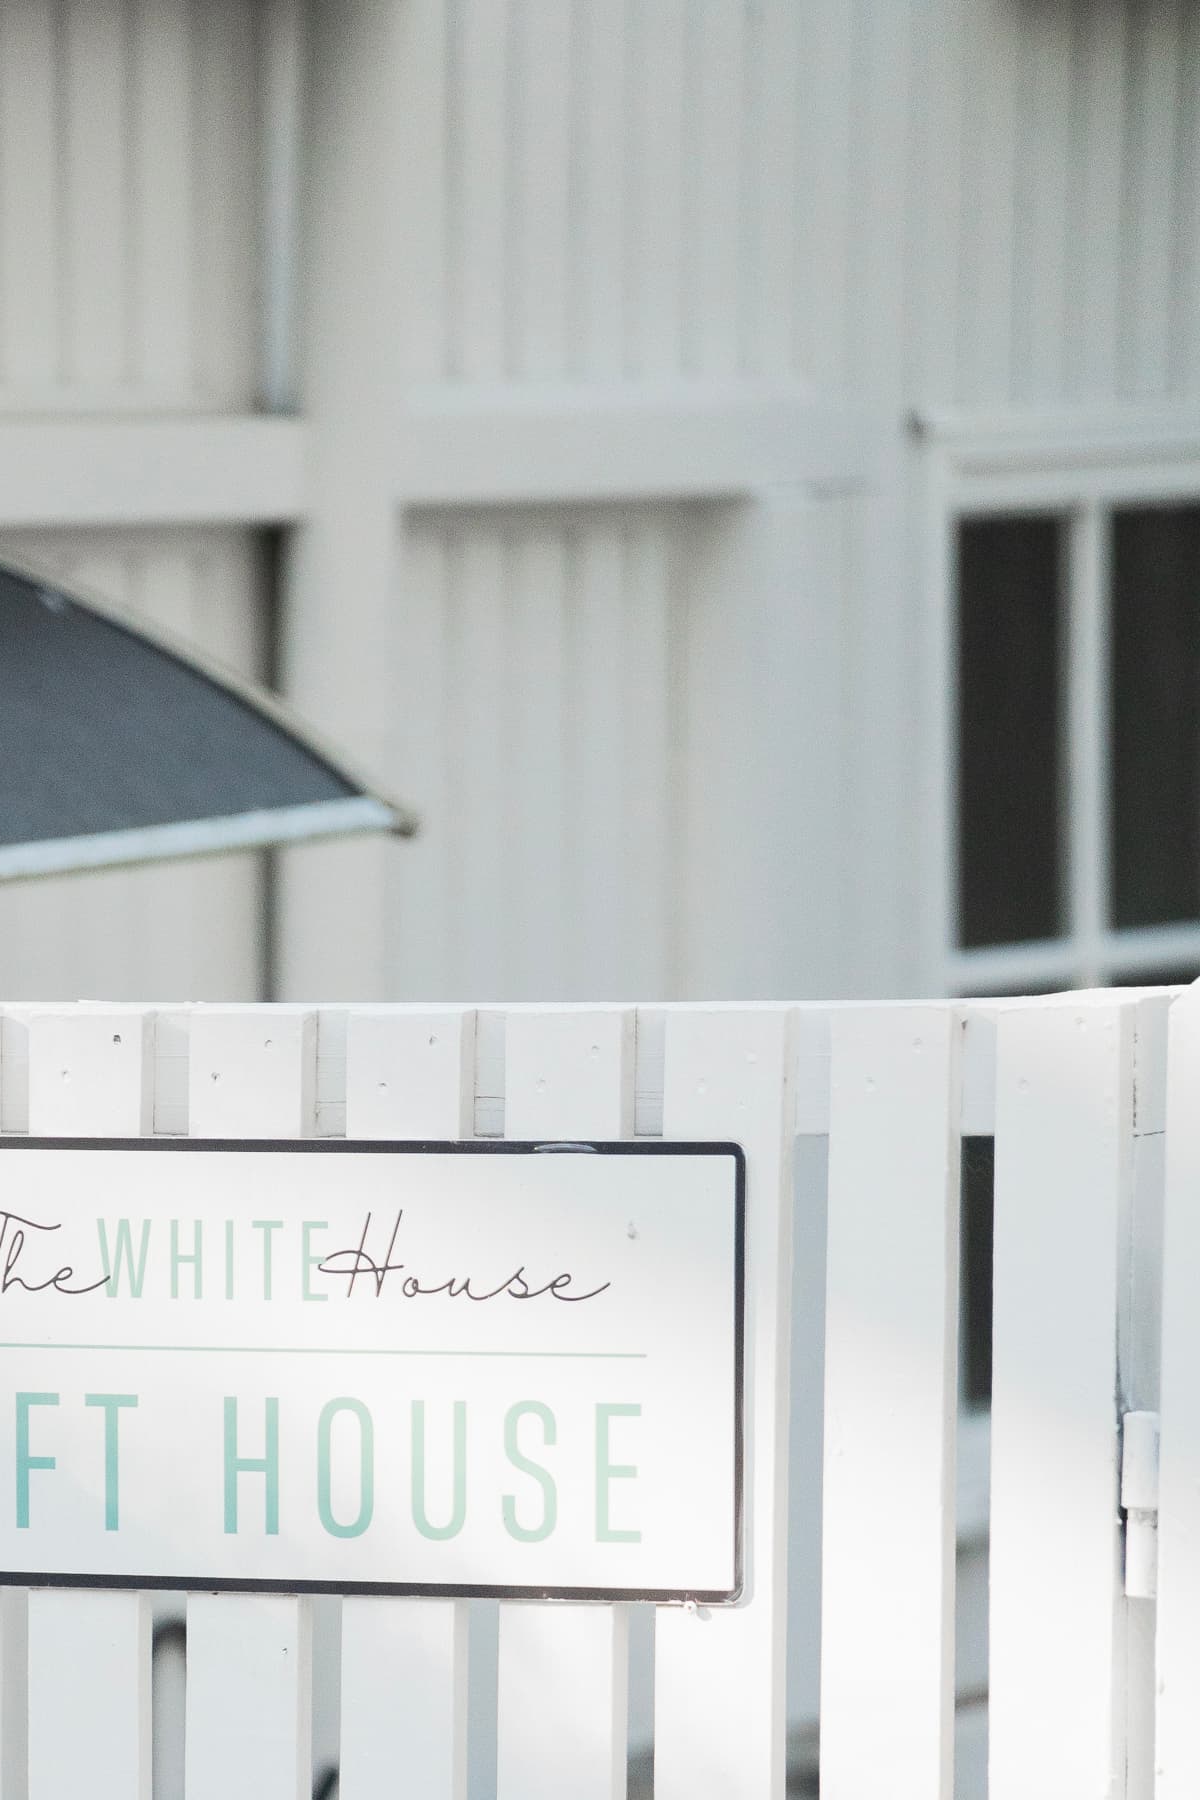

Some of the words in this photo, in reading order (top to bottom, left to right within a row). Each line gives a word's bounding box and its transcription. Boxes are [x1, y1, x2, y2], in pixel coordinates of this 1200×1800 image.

[95, 1217, 330, 1303] WHITE
[318, 1208, 610, 1303] House
[222, 1395, 643, 1544] HOUSE
